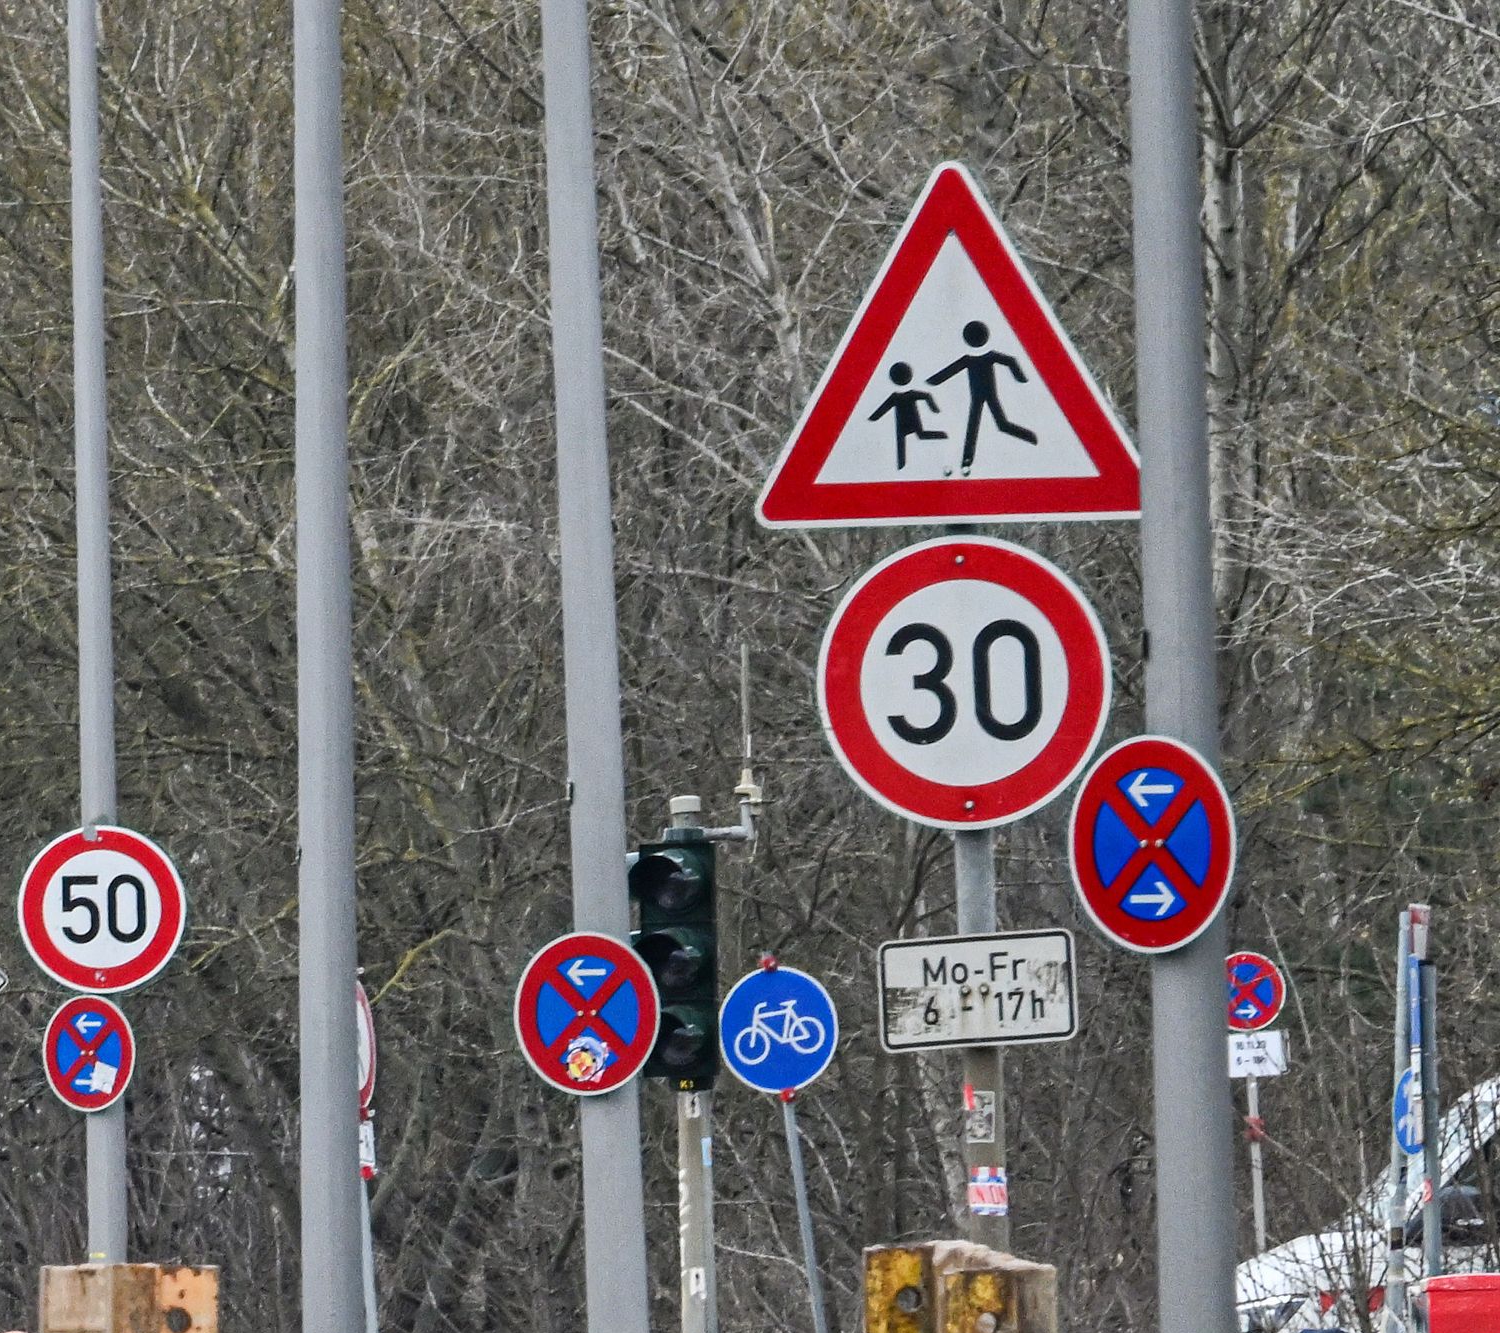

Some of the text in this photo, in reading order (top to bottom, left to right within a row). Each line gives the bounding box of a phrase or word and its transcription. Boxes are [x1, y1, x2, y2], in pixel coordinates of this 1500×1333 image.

[885, 618, 1043, 746] 30
[61, 873, 147, 945] 50
[922, 951, 1027, 987] Mo-Fr
[923, 996, 939, 1026] 6
[994, 989, 1046, 1022] 17h
